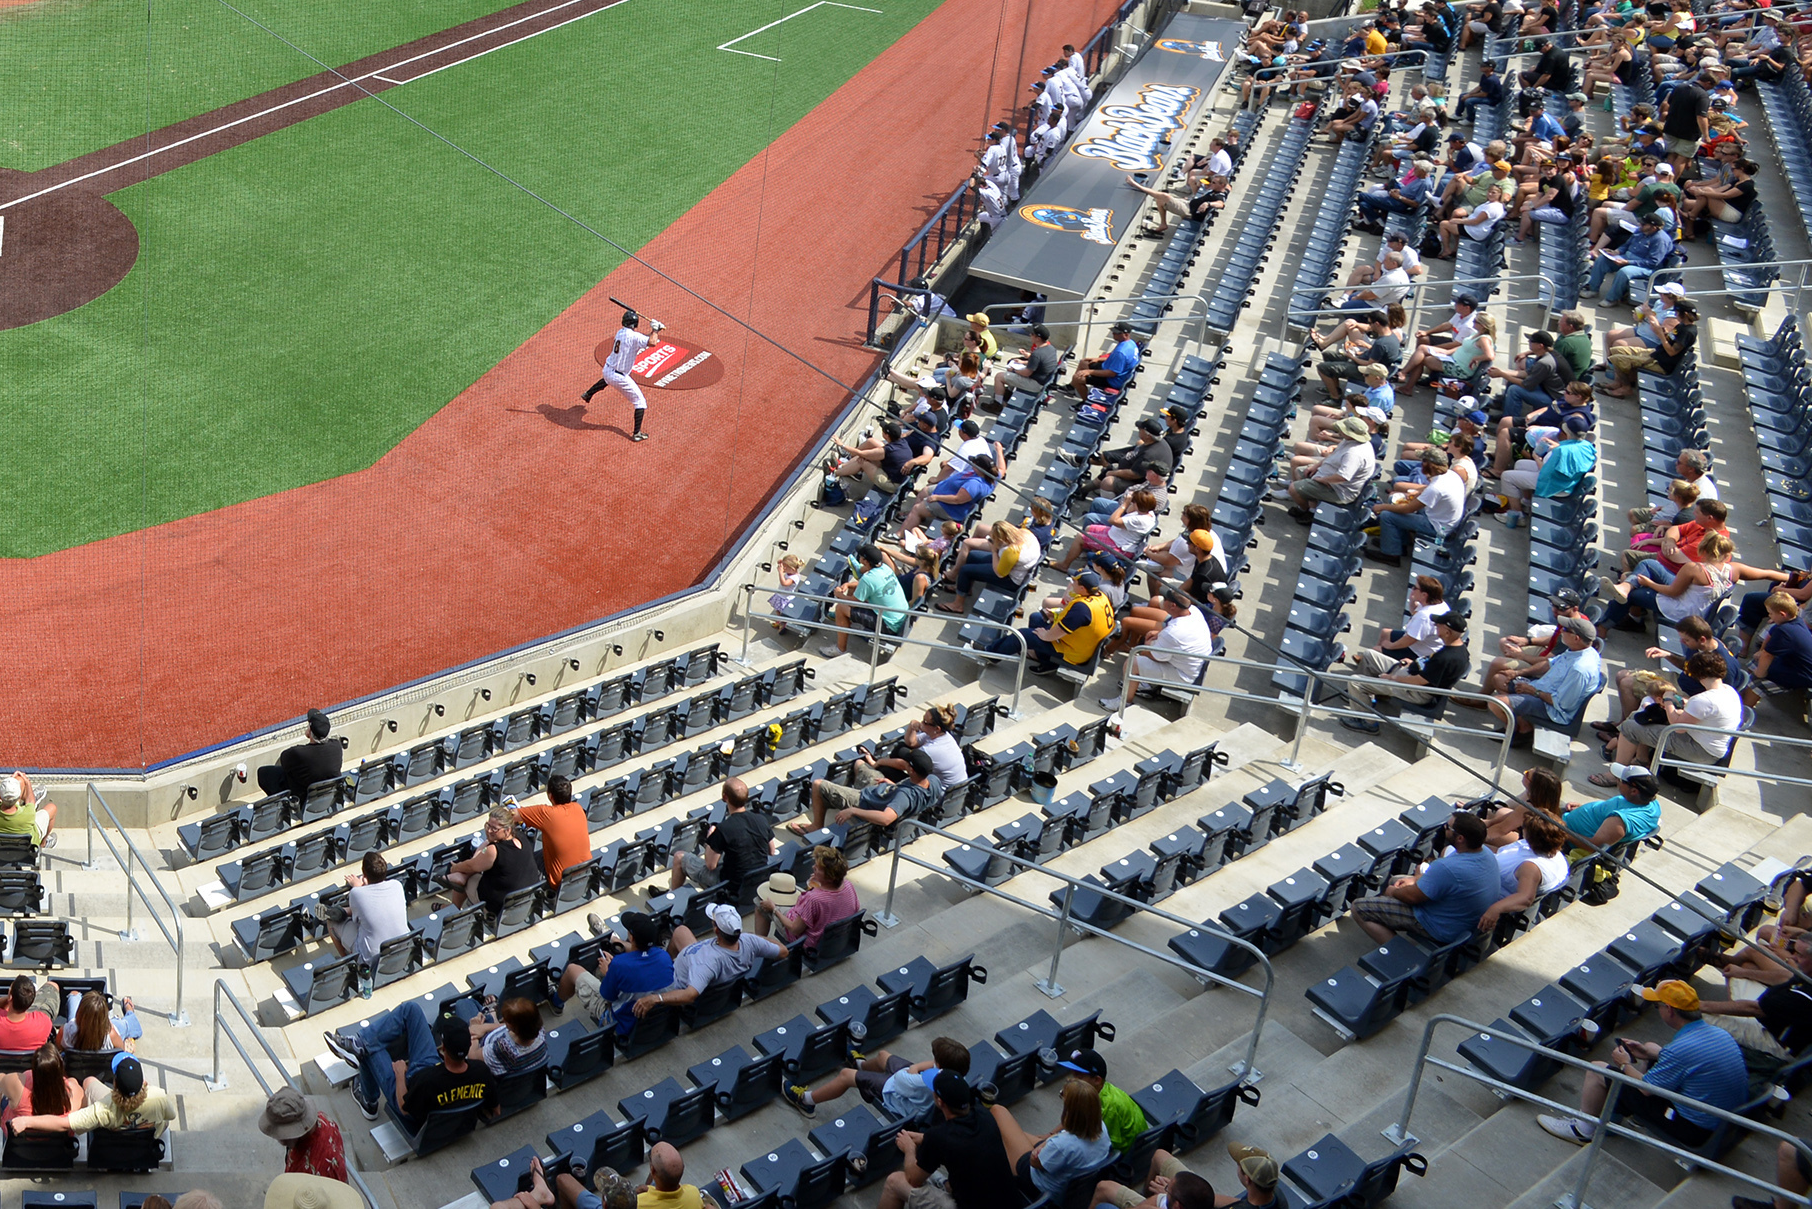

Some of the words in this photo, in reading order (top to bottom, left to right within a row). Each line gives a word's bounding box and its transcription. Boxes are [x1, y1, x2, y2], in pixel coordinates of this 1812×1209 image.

[1099, 82, 1202, 132] Bears
[1070, 118, 1172, 173] Black
[613, 339, 621, 354] 8
[631, 344, 677, 374] SPORTS
[1105, 603, 1115, 630] 8
[436, 1082, 487, 1107] CLEMENTE
